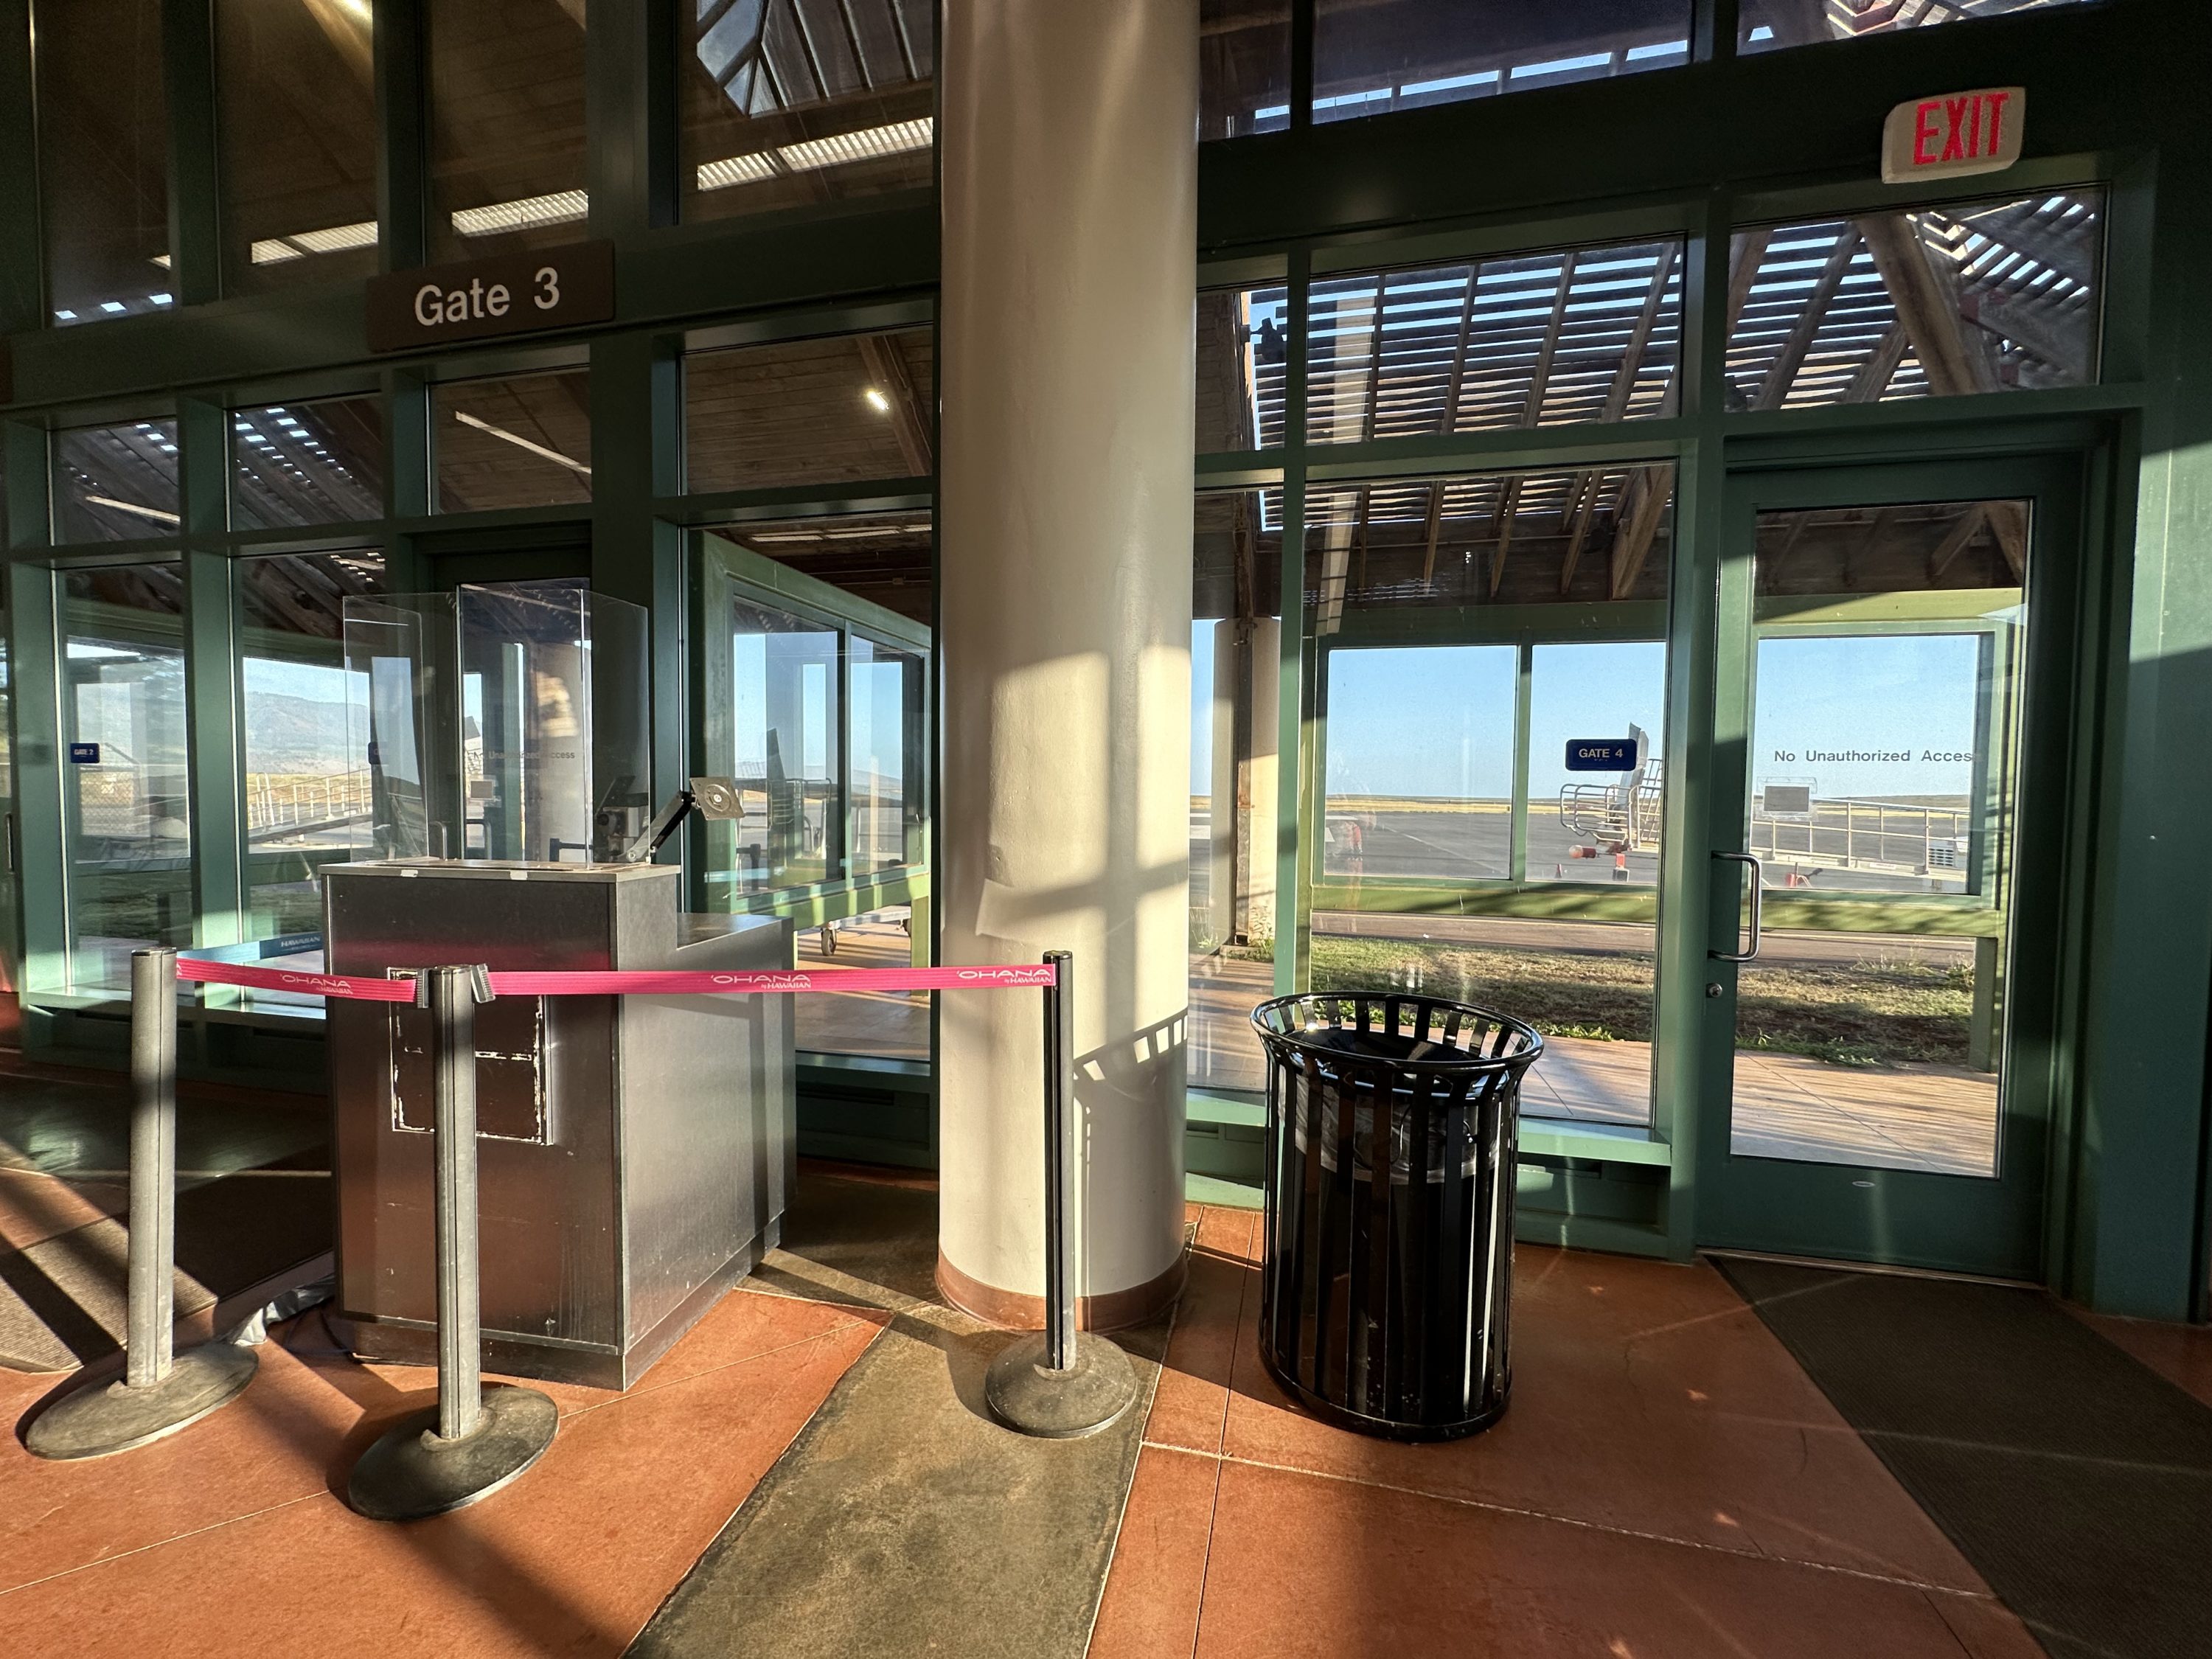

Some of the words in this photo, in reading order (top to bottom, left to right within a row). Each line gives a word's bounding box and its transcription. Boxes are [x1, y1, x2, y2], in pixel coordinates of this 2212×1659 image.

[1913, 92, 2011, 165] EXIT
[414, 278, 510, 327] Gate
[534, 267, 560, 310] 3
[1579, 748, 1610, 758] GATE
[1615, 748, 1623, 758] 4
[1774, 750, 1796, 762] No
[1805, 749, 1911, 762] Unauthorized
